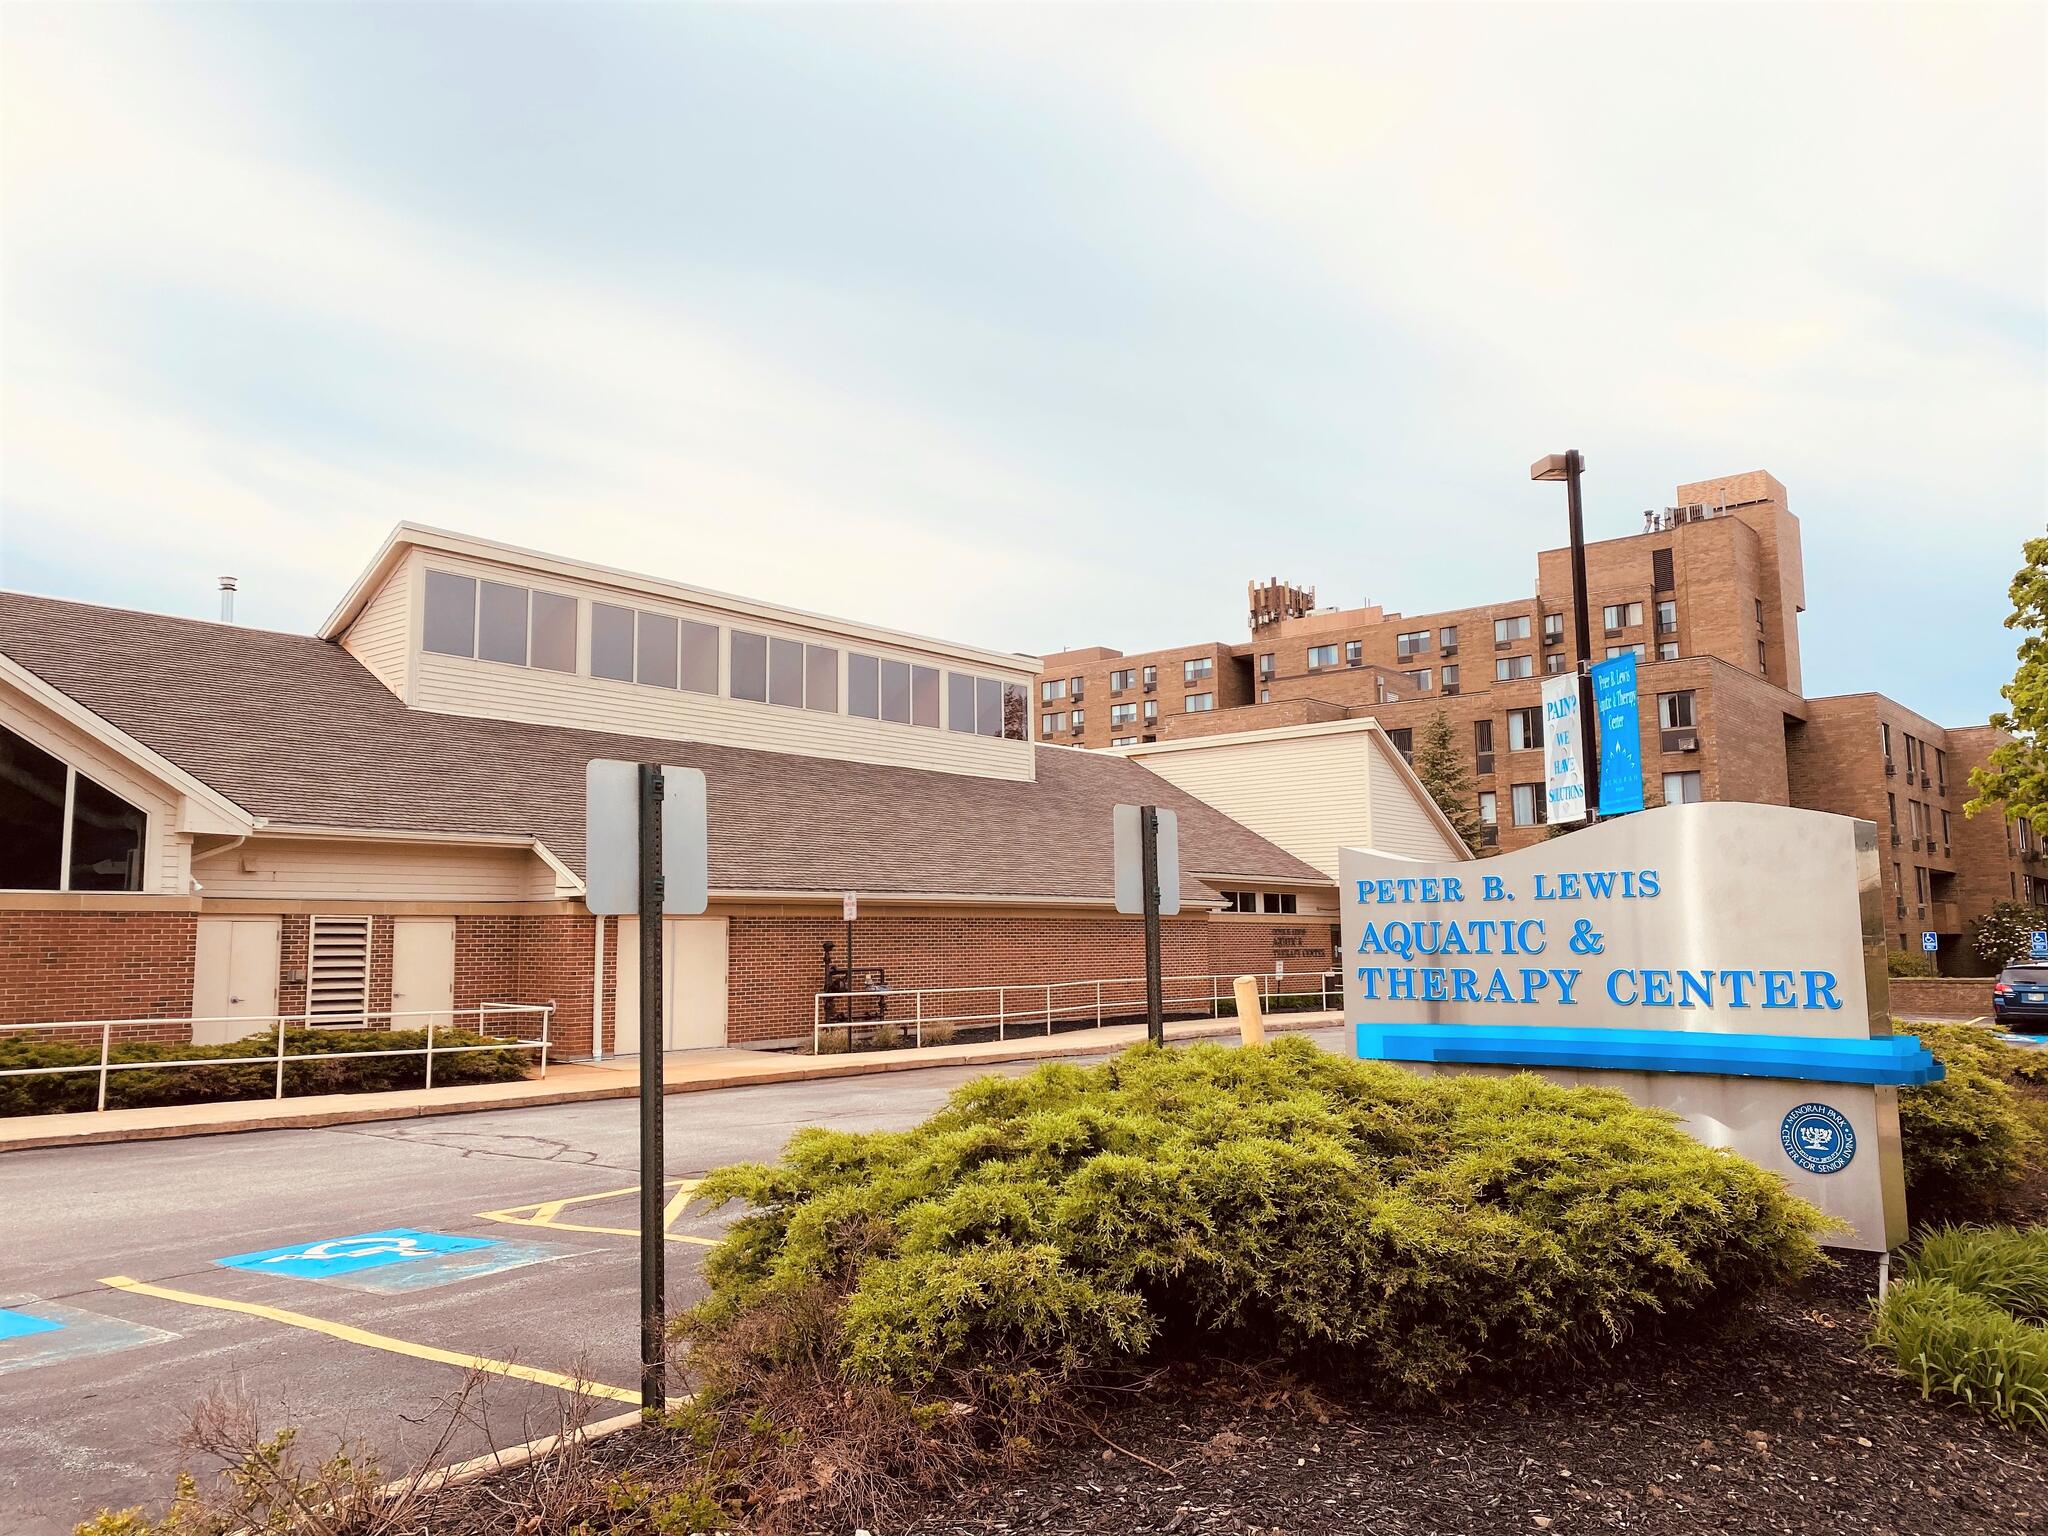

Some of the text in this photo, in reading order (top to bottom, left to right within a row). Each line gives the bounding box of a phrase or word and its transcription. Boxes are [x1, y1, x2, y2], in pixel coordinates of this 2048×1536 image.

[1546, 694, 1577, 722] PAIN?
[1608, 714, 1624, 730] Center
[1556, 731, 1570, 747] WE
[1554, 757, 1576, 775] HAVE
[1548, 783, 1584, 803] SOLUTIONS
[1356, 869, 1661, 904] PETER B. LEWIS
[1357, 918, 1605, 961] AQUATIC &
[1357, 967, 1843, 1009] THERAPY CENTER
[1787, 1105, 1847, 1127] MENORAH PARK
[1782, 1130, 1799, 1160] CENTER
[1798, 1159, 1816, 1172] FOR
[1818, 1158, 1845, 1172] SENIOR
[1843, 1134, 1853, 1159] LIVING
